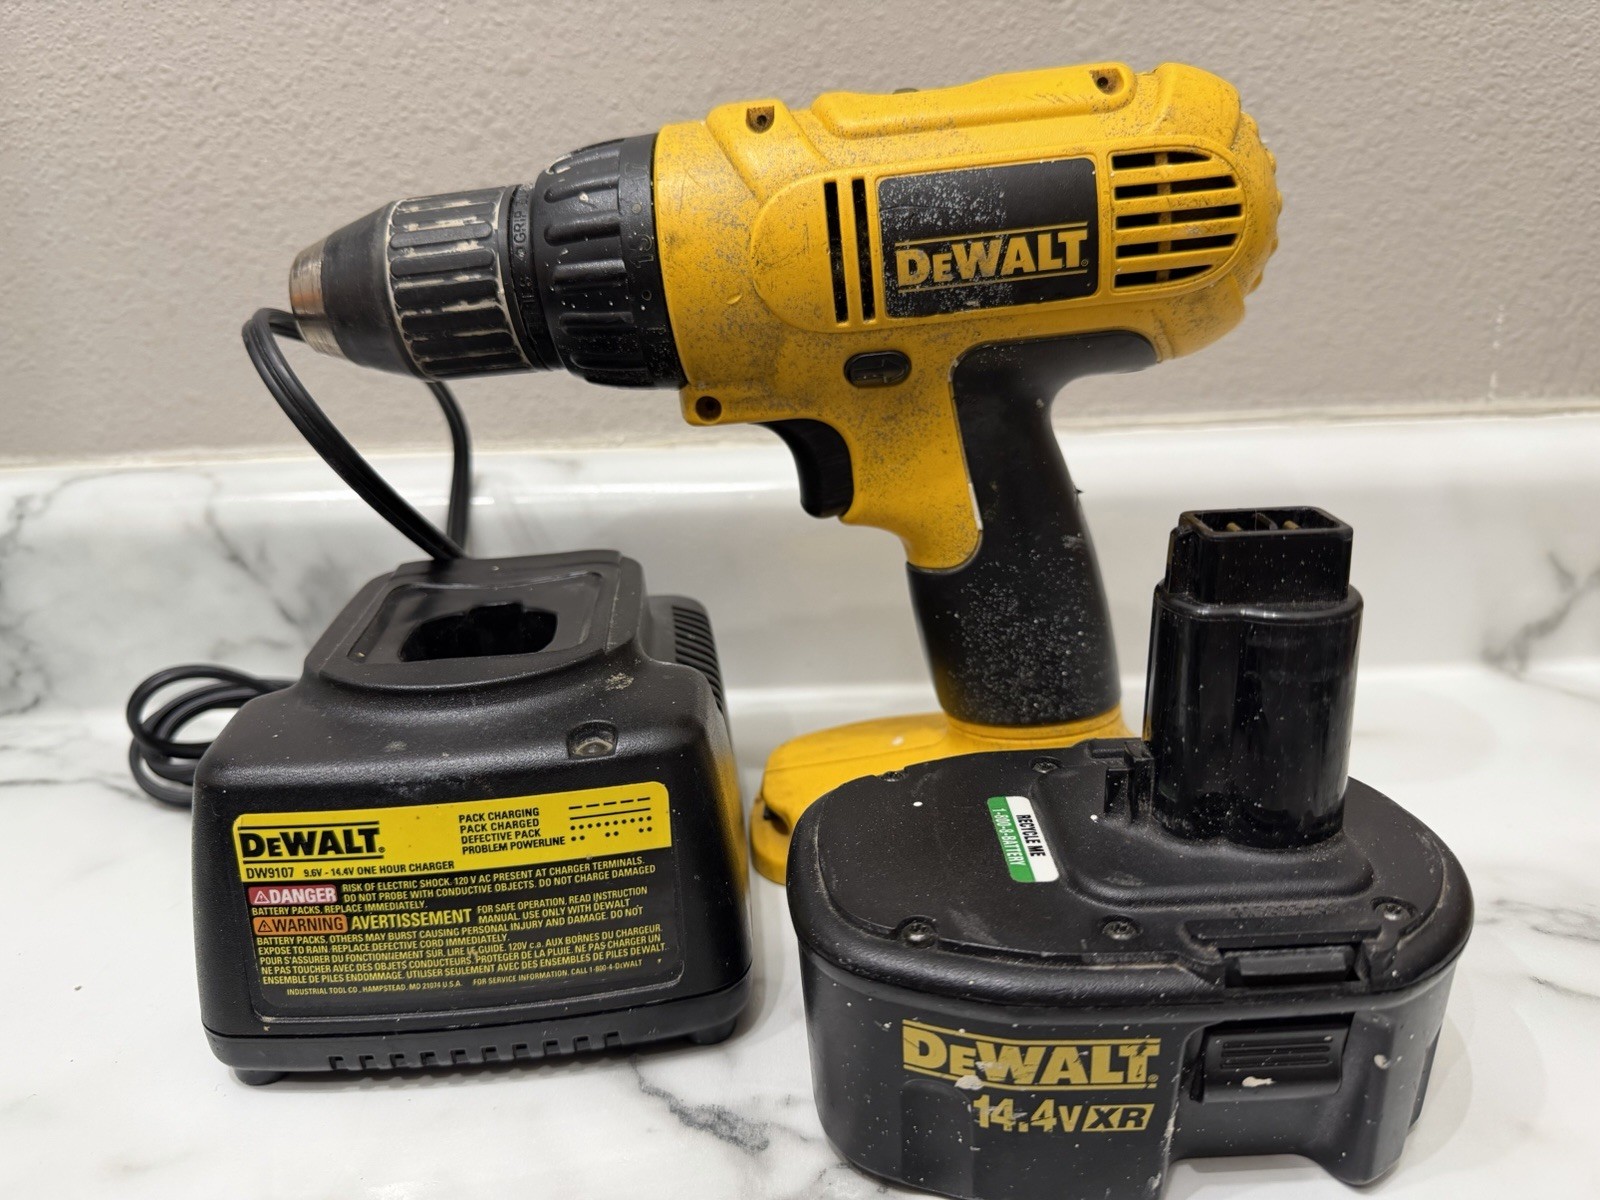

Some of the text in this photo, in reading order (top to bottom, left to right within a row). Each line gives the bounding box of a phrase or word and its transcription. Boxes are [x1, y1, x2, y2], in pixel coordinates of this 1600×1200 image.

[513, 210, 527, 243] GRIP
[459, 808, 540, 823] PACK CHARGING
[460, 818, 539, 834] PACK CHARGED
[461, 829, 541, 844] DEFECTIVE PACK
[462, 836, 566, 855] PROBLEM POWERLINE
[992, 808, 1026, 866] 1-800-8-BATTERY
[1016, 814, 1046, 856] RECYCLE ME
[246, 866, 294, 879] DW9107
[303, 868, 322, 878] 9.6V
[330, 866, 354, 876] 14.4V
[357, 866, 378, 874] ONE
[380, 864, 406, 874] HOUR
[408, 860, 454, 872] CHARGER
[342, 856, 645, 892] RISK OF ELECTRIC SHOCK. 120 V AC PRESENT AT CHARGER TERMINALS.
[344, 864, 656, 902] DO NOT PROBE WITH CONDUCTIVE OBJECTS. DO NOT CHARGE DAMAGED
[252, 900, 428, 916] BATTERY PACKS. REPLACE IMMEDIATELY.
[269, 888, 336, 904] DANGER
[478, 886, 648, 914] FOR SAFE OPERATION. READ INSTRUCTION
[272, 908, 472, 932] WARNING AVERTISSEMENT
[479, 898, 630, 924] MANUAL. USE ONLY WITH DEWALT
[256, 906, 644, 946] BATTERY PACKS. OTHERS MAY BURST CAUSING PERSONAL INJURY AND DAMAGE. DO NOT
[258, 946, 292, 956] EXPOSE
[293, 946, 304, 954] TO
[332, 944, 370, 952] REPLACE
[372, 940, 418, 952] DEFECTIVE
[420, 939, 444, 948] CORD
[446, 933, 510, 946] IMMEDIATELY.
[260, 956, 282, 965] POUR
[284, 954, 330, 964] S'ASSURER
[332, 954, 344, 963] DU
[447, 947, 464, 956] LIRE
[478, 942, 506, 954] GUIDE.
[508, 942, 528, 951] 120V
[545, 937, 564, 946] AUX
[565, 932, 600, 944] BORNES
[602, 930, 614, 940] DU
[616, 924, 663, 938] CHARGEUR.
[261, 966, 273, 975] NE
[274, 966, 292, 974] PAS
[293, 964, 332, 974] TOUCHER
[333, 964, 355, 972] AVEC
[356, 963, 373, 972] DES
[374, 960, 408, 970] OBJETS
[475, 952, 520, 964] PROTEGER
[521, 950, 532, 959] DE
[534, 948, 546, 958] LA
[548, 946, 574, 957] PLUIE.
[575, 944, 587, 952] NE
[588, 941, 606, 952] PAS
[608, 936, 646, 948] CHARGER
[648, 934, 661, 943] UN
[262, 974, 308, 985] ENSEMBLE
[308, 974, 320, 984] DE
[322, 974, 344, 982] PILES
[406, 968, 443, 979] UTILISER
[444, 964, 495, 976] SEULEMENT
[498, 962, 520, 972] AVEC
[521, 960, 538, 970] DES
[540, 954, 591, 968] ENSEMBLES
[592, 952, 604, 960] DE
[606, 949, 628, 959] PILES
[286, 987, 328, 996] INDUSTRIAL
[422, 982, 441, 990] 21074
[488, 976, 516, 984] SERVICE
[973, 1094, 1150, 1132] 14.4V XR
